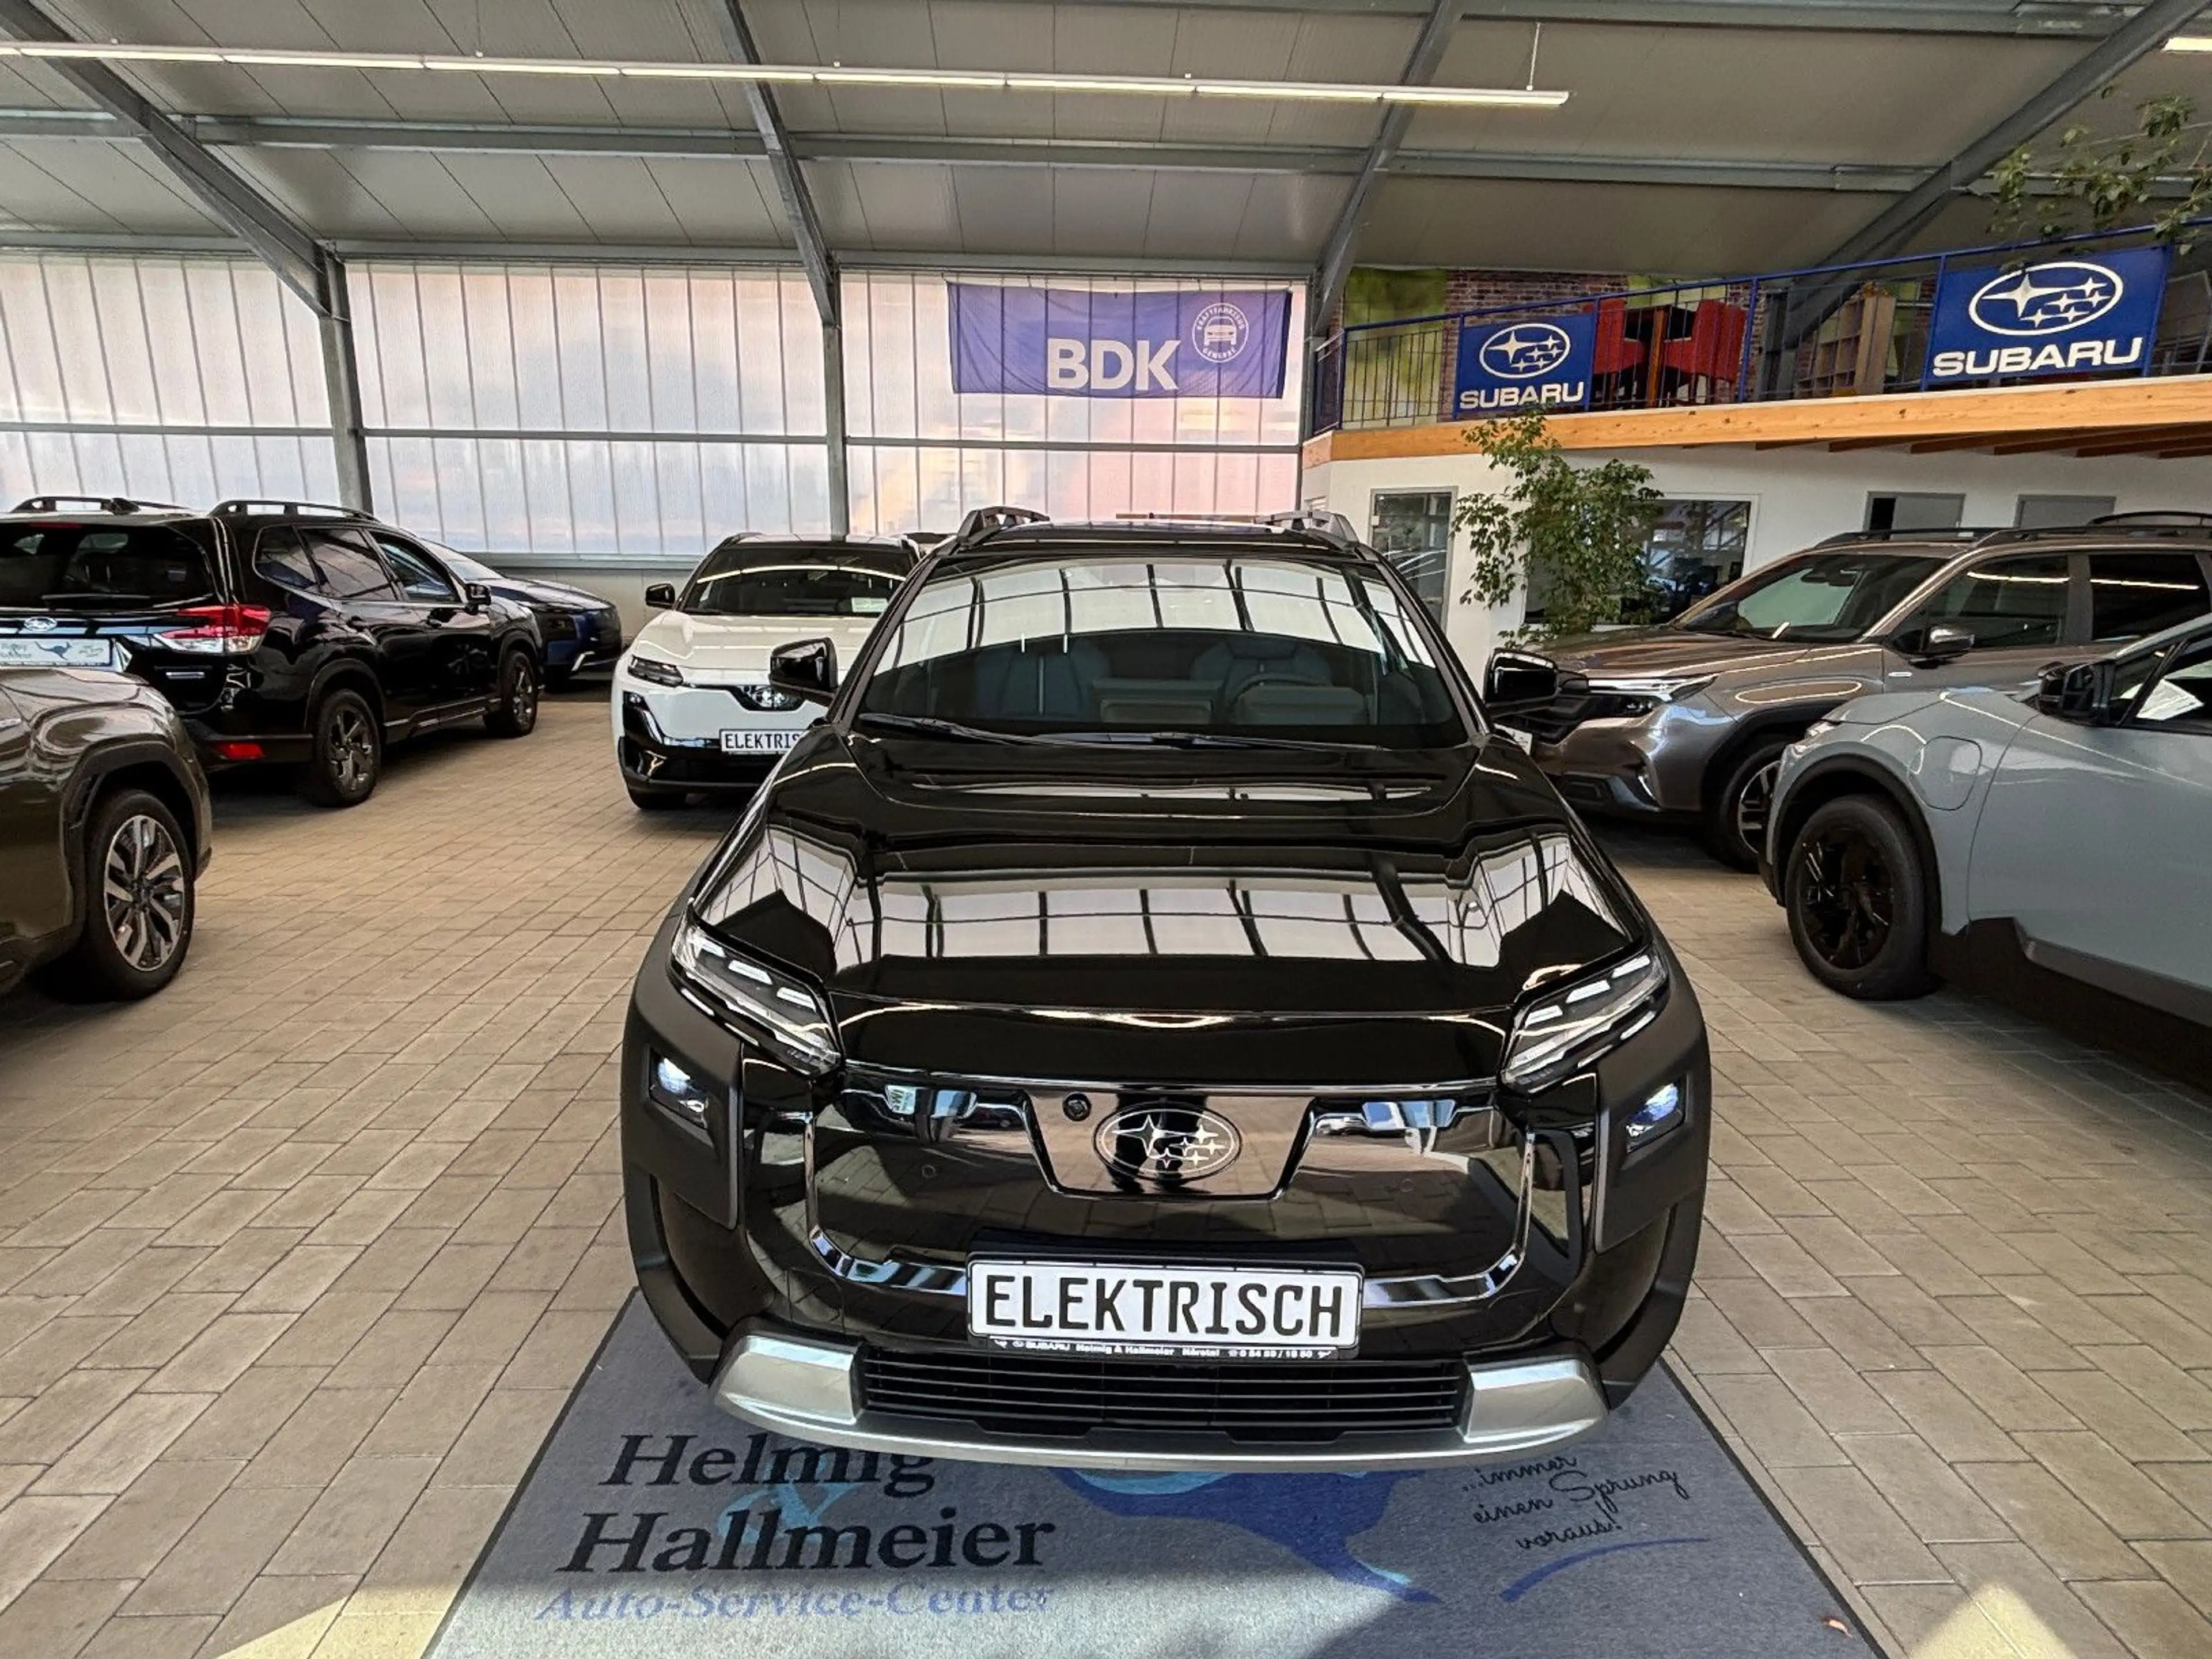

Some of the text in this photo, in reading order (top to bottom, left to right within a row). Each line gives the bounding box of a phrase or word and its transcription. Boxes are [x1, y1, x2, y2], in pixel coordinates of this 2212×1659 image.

[1047, 338, 1181, 391] BDK
[1932, 336, 2143, 377] SUBARU
[1459, 381, 1585, 409] SUBARU
[725, 733, 800, 749] ELEKTRI
[985, 1274, 1343, 1338] ELEKTRISCH
[1025, 1340, 1070, 1351] SUBARU
[598, 1434, 935, 1498] Helmig
[1473, 1469, 1690, 1524] einen Sprung
[555, 1506, 1055, 1574] Hallmeier
[533, 1581, 1054, 1622] Auto-Service-Center
